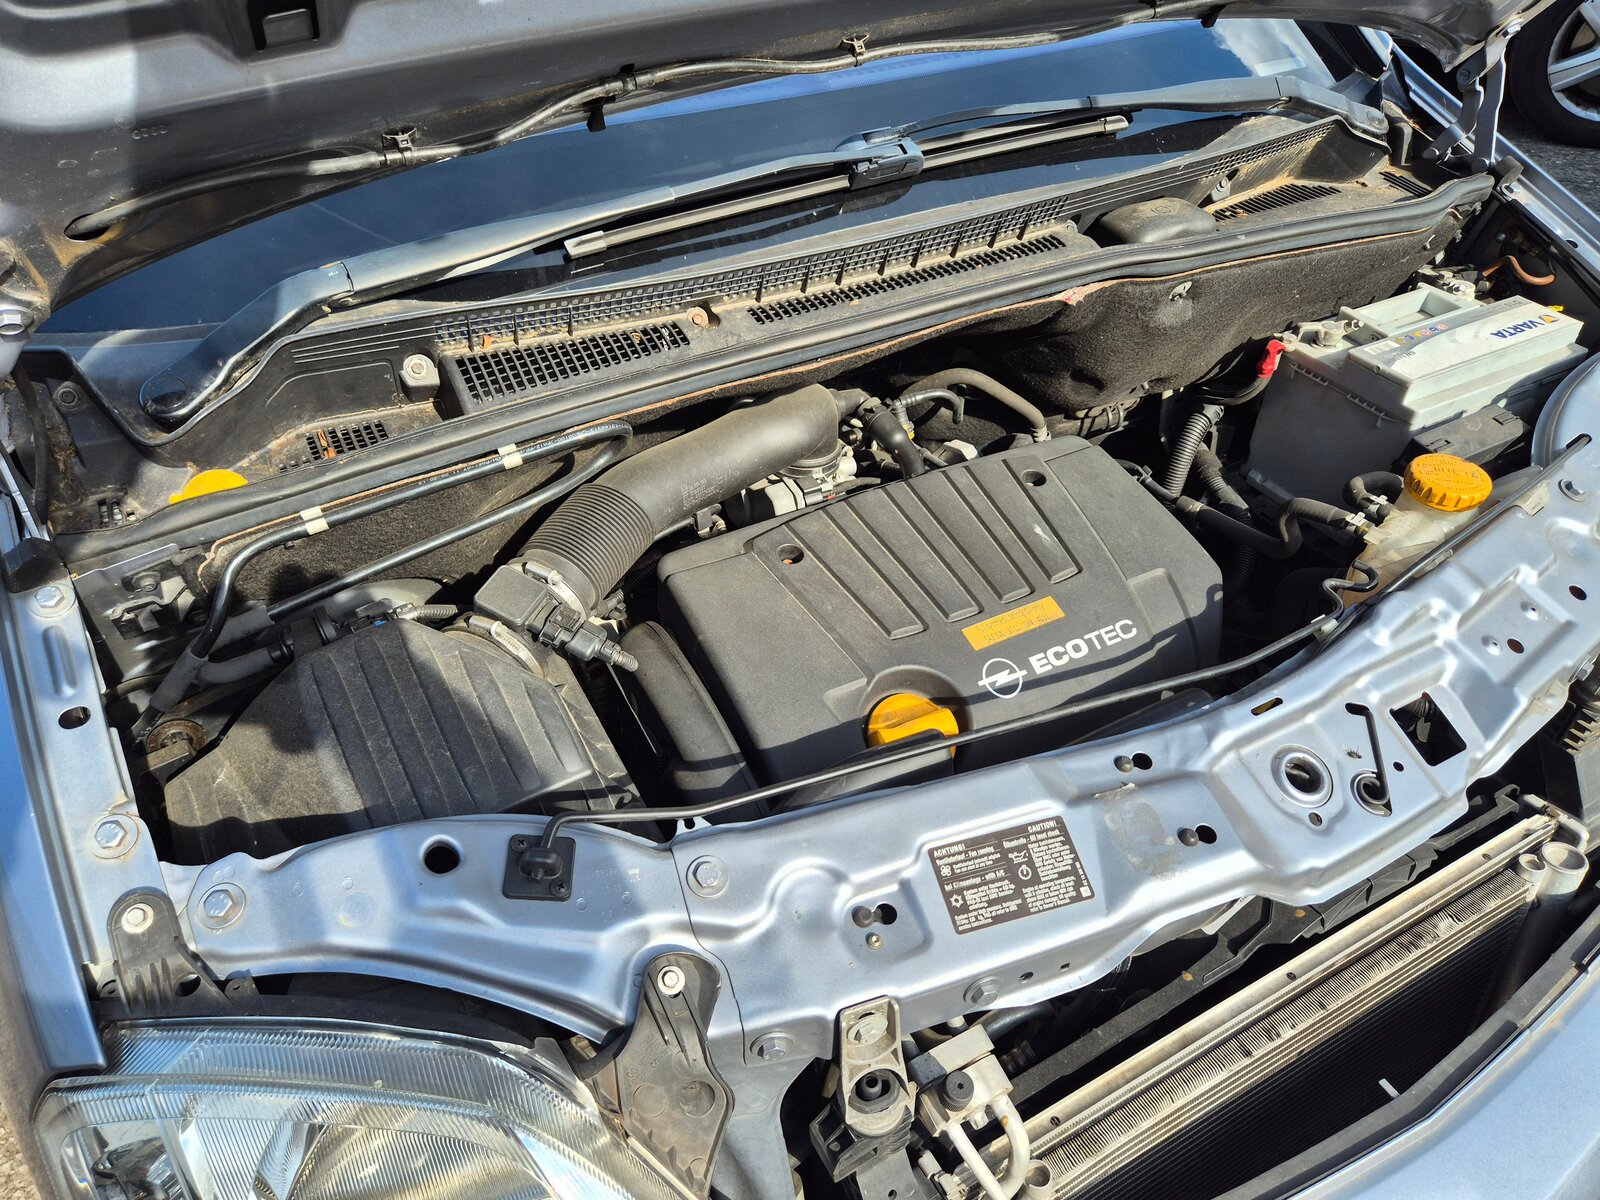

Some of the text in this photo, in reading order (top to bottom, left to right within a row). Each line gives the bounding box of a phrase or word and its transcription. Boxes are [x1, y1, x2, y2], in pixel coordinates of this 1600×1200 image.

[1491, 319, 1545, 339] VARTA
[1028, 618, 1138, 675] ECOTEC
[1028, 820, 1057, 833] CAUTION!
[934, 843, 966, 858] ACHTUNG!
